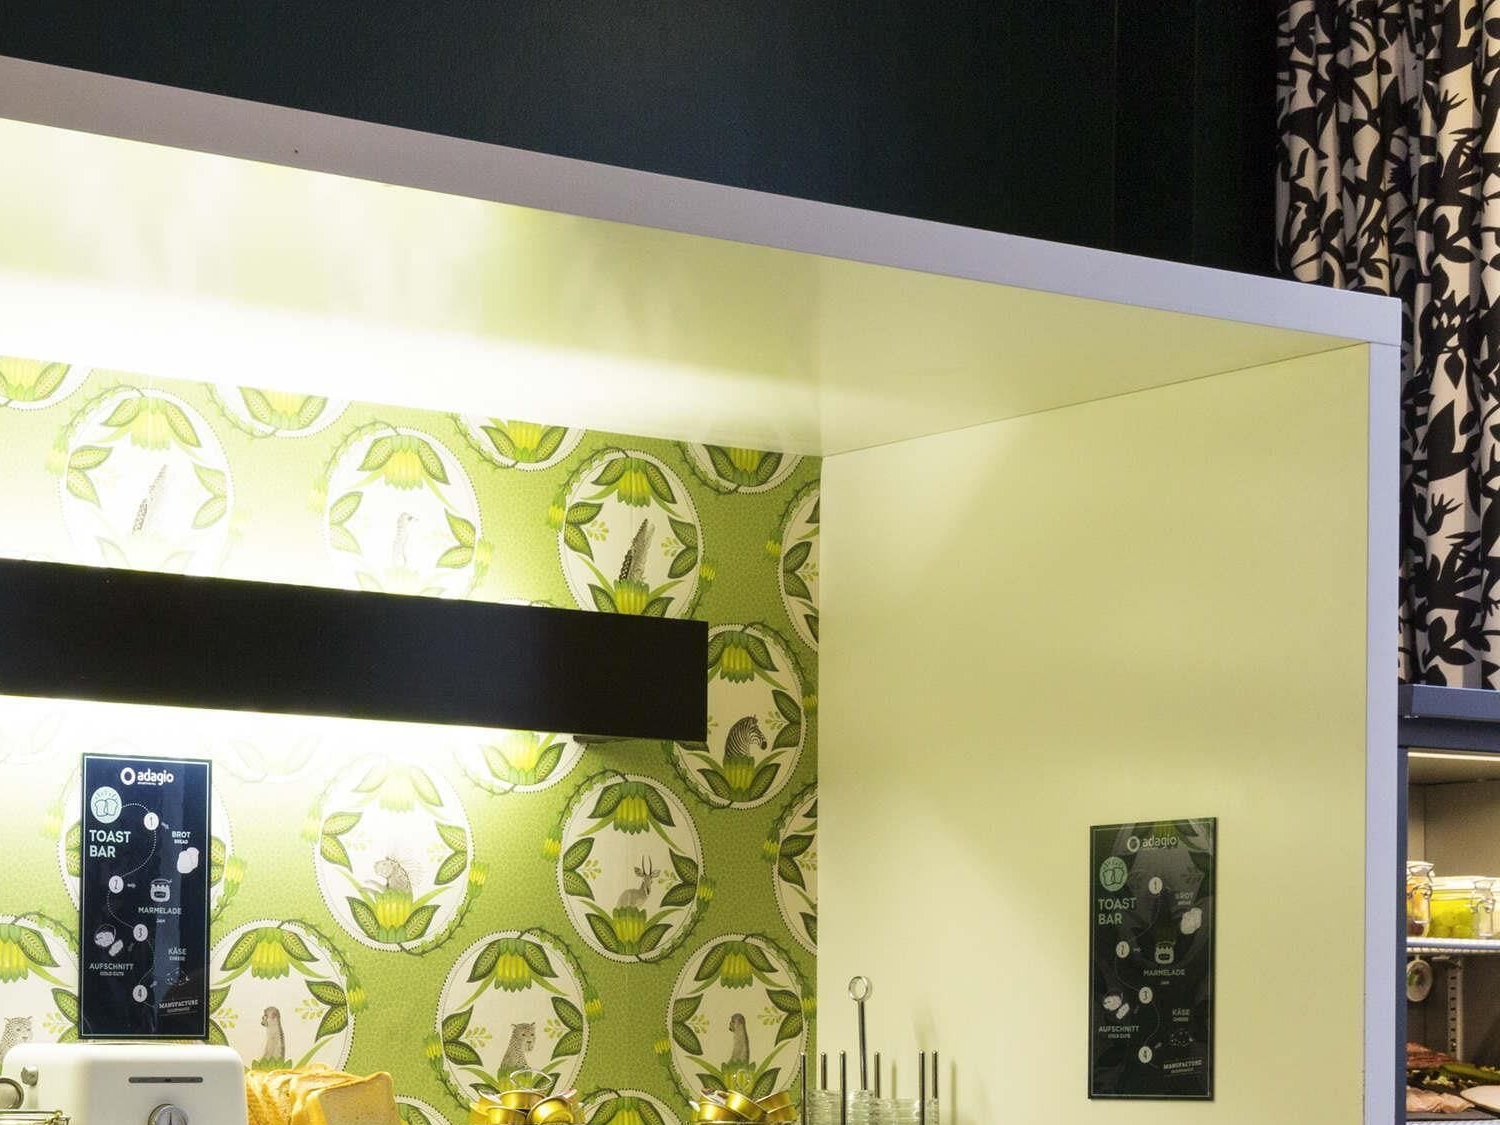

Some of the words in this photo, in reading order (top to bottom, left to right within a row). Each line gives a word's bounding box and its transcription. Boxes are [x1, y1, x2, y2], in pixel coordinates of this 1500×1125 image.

[137, 768, 174, 786] adagio
[89, 829, 131, 844] TOAST
[171, 831, 192, 839] BROT
[1142, 833, 1178, 849] adagio
[89, 845, 116, 858] BAR
[1098, 897, 1137, 910] TOAST
[138, 906, 182, 915] MARMELADE
[1098, 913, 1123, 925] BAR
[89, 963, 135, 971] AUFSCHNITT
[1099, 1025, 1140, 1033] AUFSCHNITT
